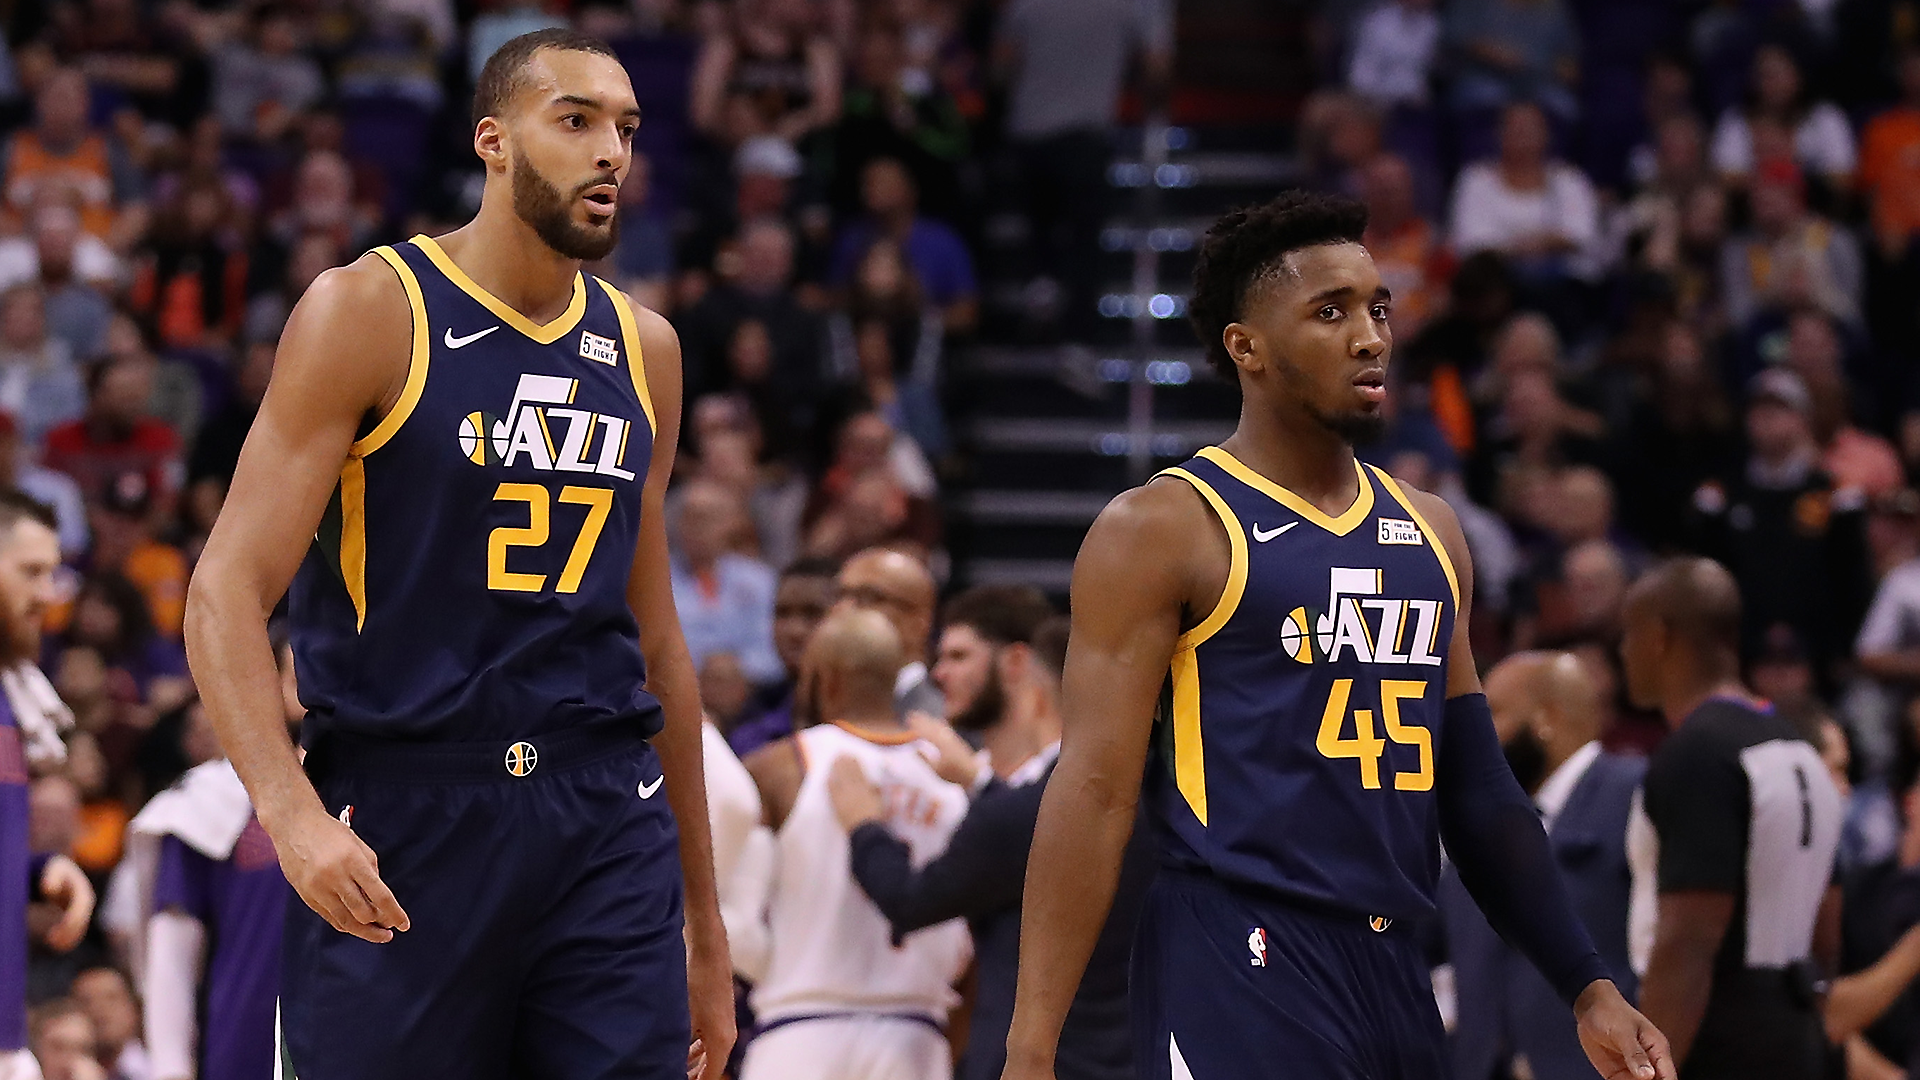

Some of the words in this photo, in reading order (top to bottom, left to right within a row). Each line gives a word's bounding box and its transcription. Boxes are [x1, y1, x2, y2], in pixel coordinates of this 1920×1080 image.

[583, 335, 591, 354] 5
[593, 348, 614, 361] FIGHT
[489, 373, 636, 482] JAZZ
[487, 482, 615, 594] 27
[1381, 522, 1390, 541] 5
[1394, 532, 1418, 541] FIGHT
[1313, 566, 1444, 666] JAZZ
[1315, 678, 1435, 792] 45
